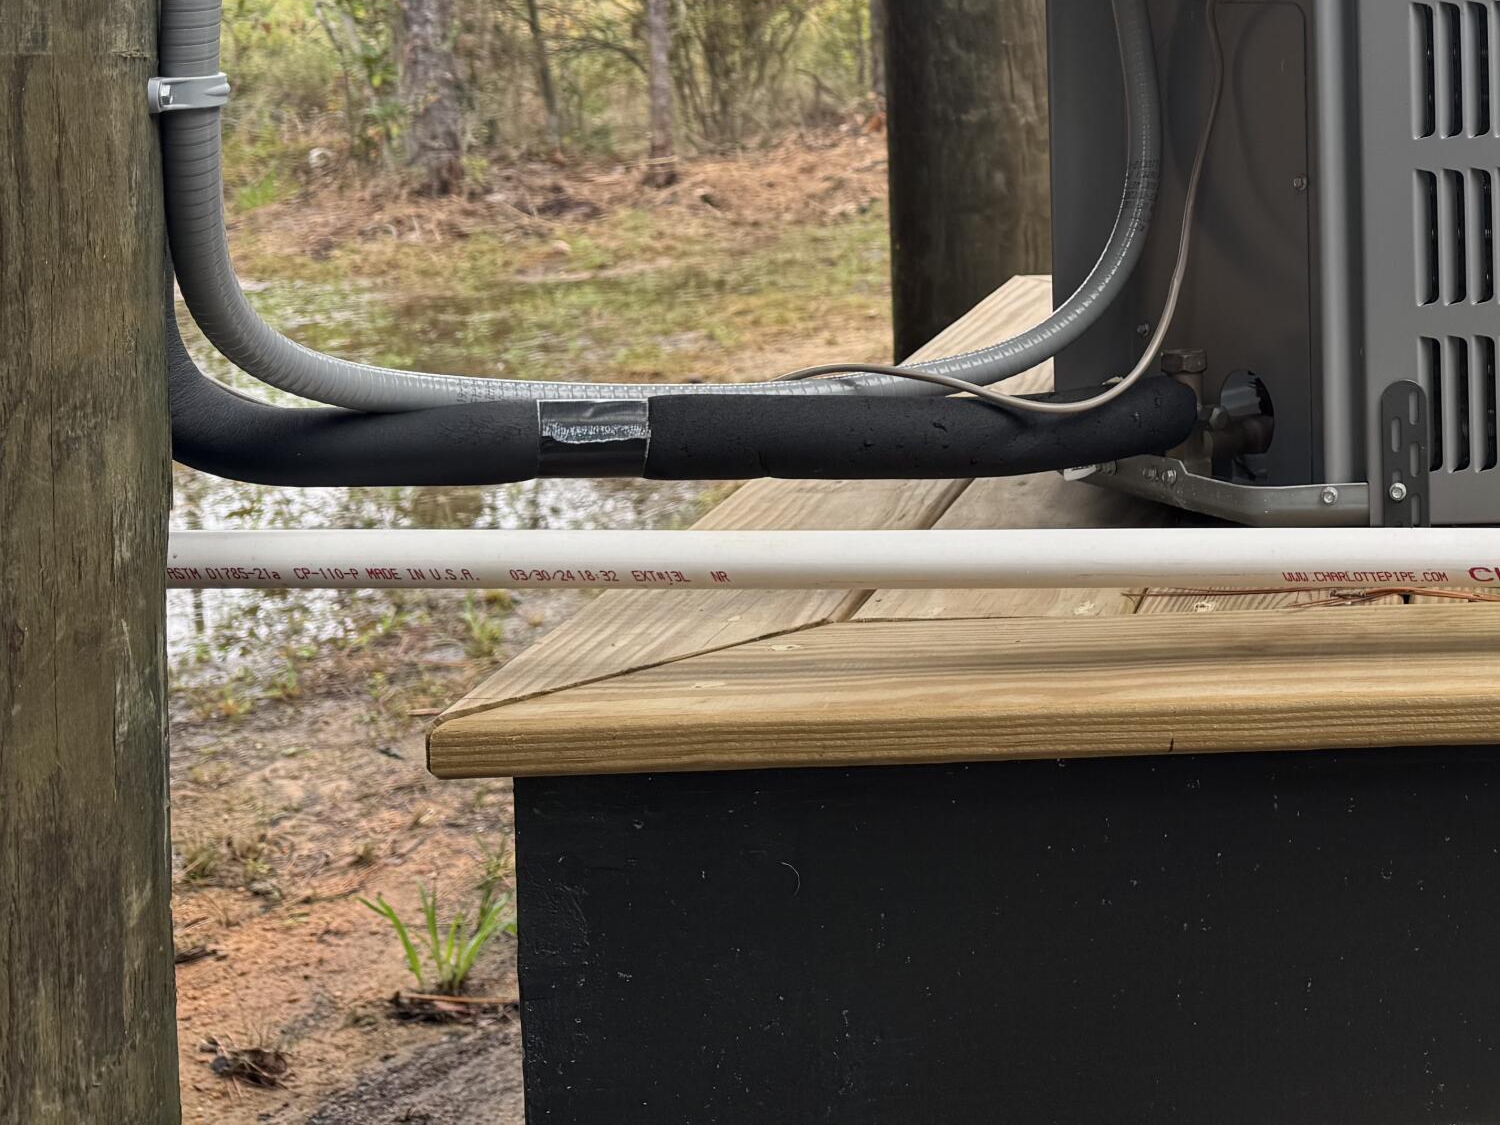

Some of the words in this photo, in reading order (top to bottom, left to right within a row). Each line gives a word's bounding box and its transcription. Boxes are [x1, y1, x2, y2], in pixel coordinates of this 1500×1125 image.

[166, 567, 201, 580] ASTM
[293, 567, 359, 580] CP-110-P
[365, 568, 402, 581] MADE
[406, 568, 426, 580] IN
[429, 568, 480, 581] U.S.A.
[509, 569, 576, 582] 03/30/24
[578, 570, 620, 582] 18:32
[710, 571, 731, 582] NR
[1281, 571, 1449, 583] WWW.CHARLOTTEPIPE.COM
